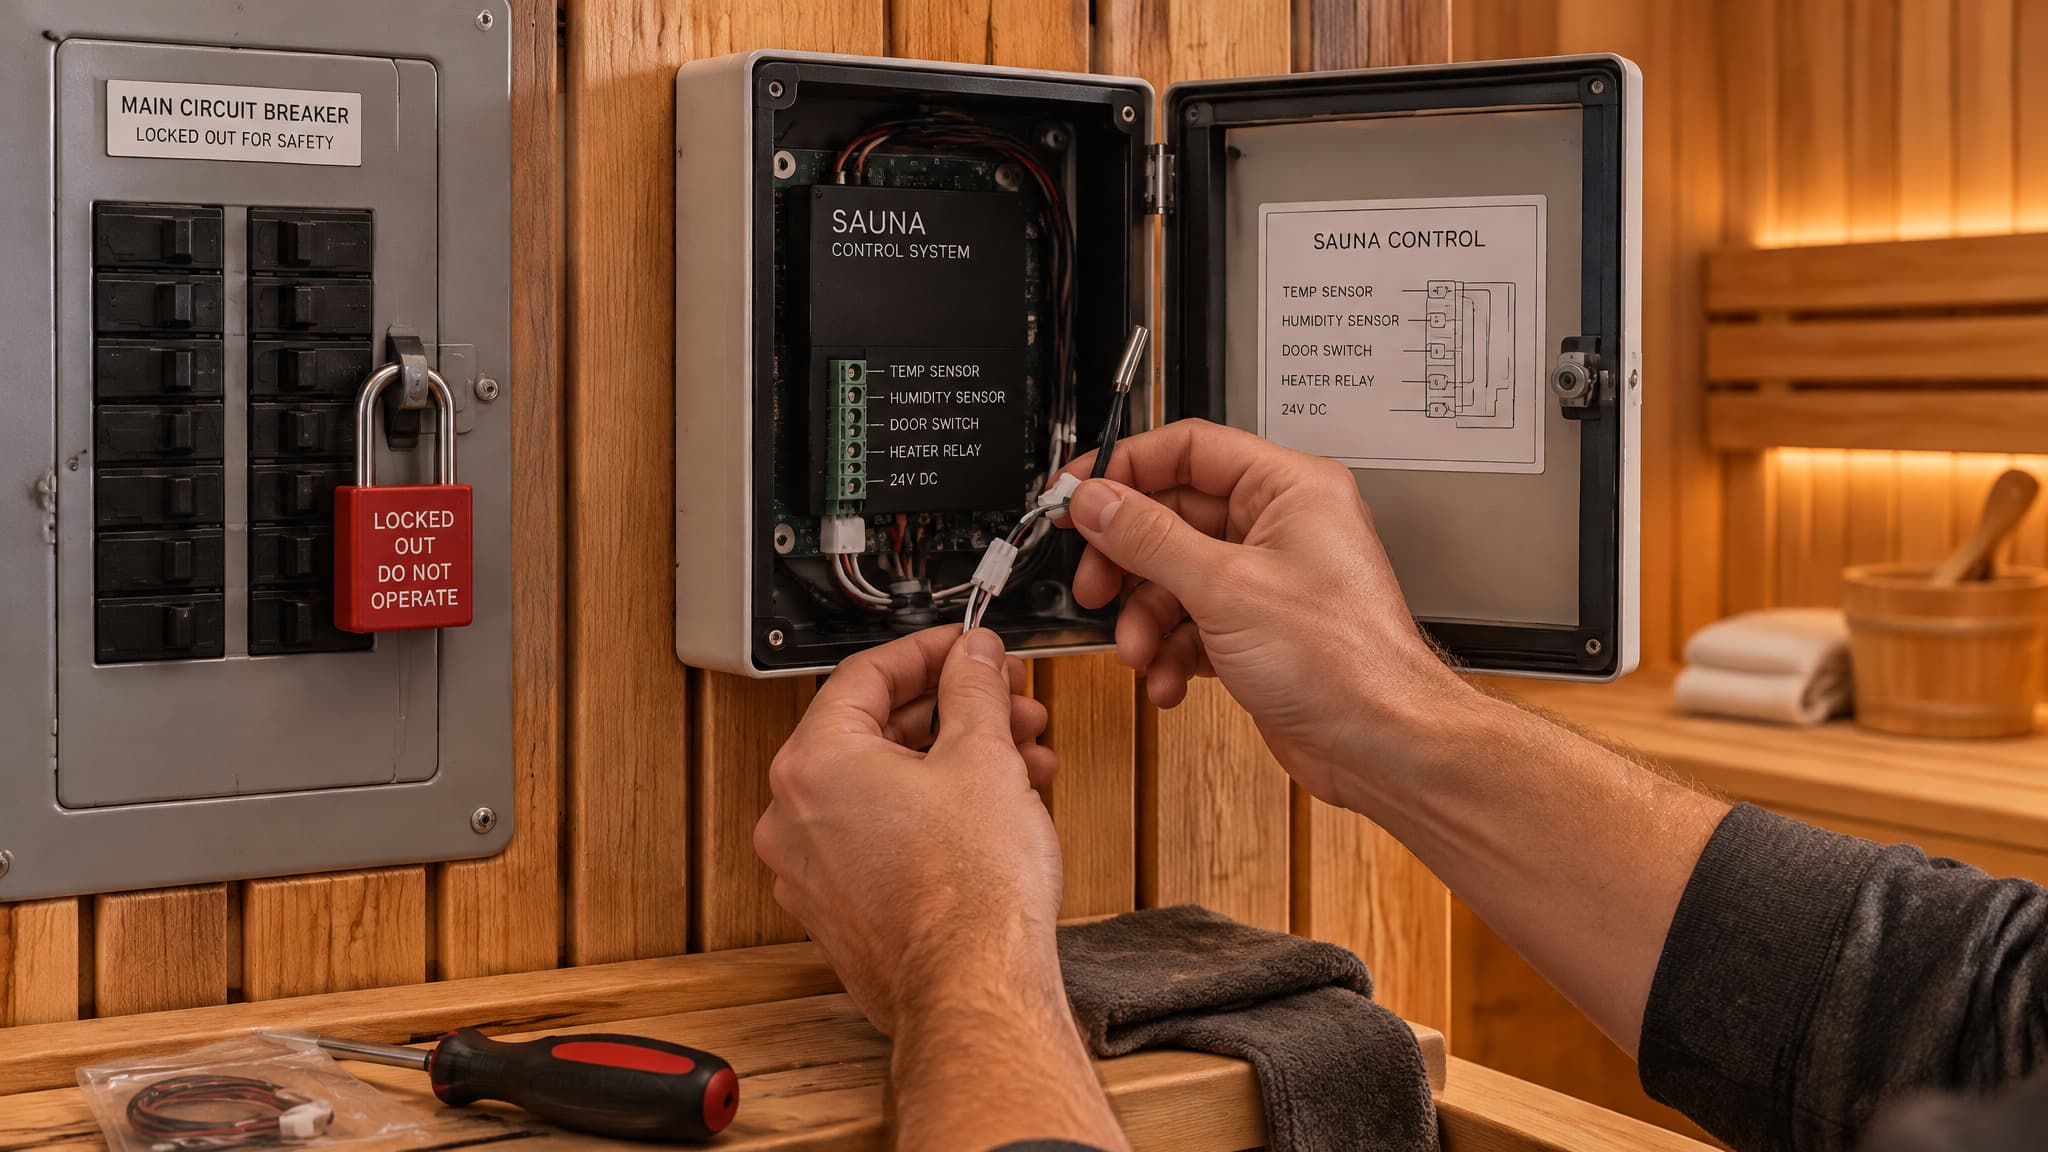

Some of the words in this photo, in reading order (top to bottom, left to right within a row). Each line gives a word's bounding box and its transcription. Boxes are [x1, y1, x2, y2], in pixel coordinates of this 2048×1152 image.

[121, 95, 173, 116] MAIN
[180, 98, 258, 120] CIRCUIT
[264, 102, 349, 124] BREAKER
[136, 126, 199, 144] LOCKED
[204, 129, 237, 146] OUT
[242, 131, 272, 148] FOR
[277, 133, 334, 150] SAFETY
[832, 208, 926, 235] SAUNA
[1313, 231, 1381, 250] SAUNA
[1388, 229, 1486, 249] CONTROL
[831, 242, 904, 258] CONTROL
[909, 243, 970, 259] SYSTEM
[1282, 285, 1317, 298] TEMP
[1322, 285, 1373, 298] SENSOR
[1282, 314, 1344, 328] HUMIDITY
[1347, 314, 1400, 327] SENSOR
[1282, 343, 1318, 357] DOOR
[1323, 344, 1372, 357] SWITCH
[889, 364, 925, 378] TEMP
[929, 364, 980, 378] SENSOR
[1281, 374, 1331, 387] HEATER
[1335, 374, 1375, 388] RELAY
[890, 391, 952, 405] HUMIDITY
[955, 390, 1006, 404] SENSOR
[1281, 403, 1305, 416] 24V
[1309, 402, 1327, 416] DC
[890, 417, 928, 431] DOOR
[931, 417, 979, 431] SWITCH
[890, 444, 939, 459] HEATER
[943, 443, 982, 457] RELAY
[889, 472, 916, 487] 24V
[919, 471, 938, 486] DC
[374, 510, 455, 530] LOCKED
[394, 536, 436, 555] OUT
[378, 564, 406, 583] DO
[413, 562, 452, 582] NOT
[371, 588, 459, 610] OPERATE
